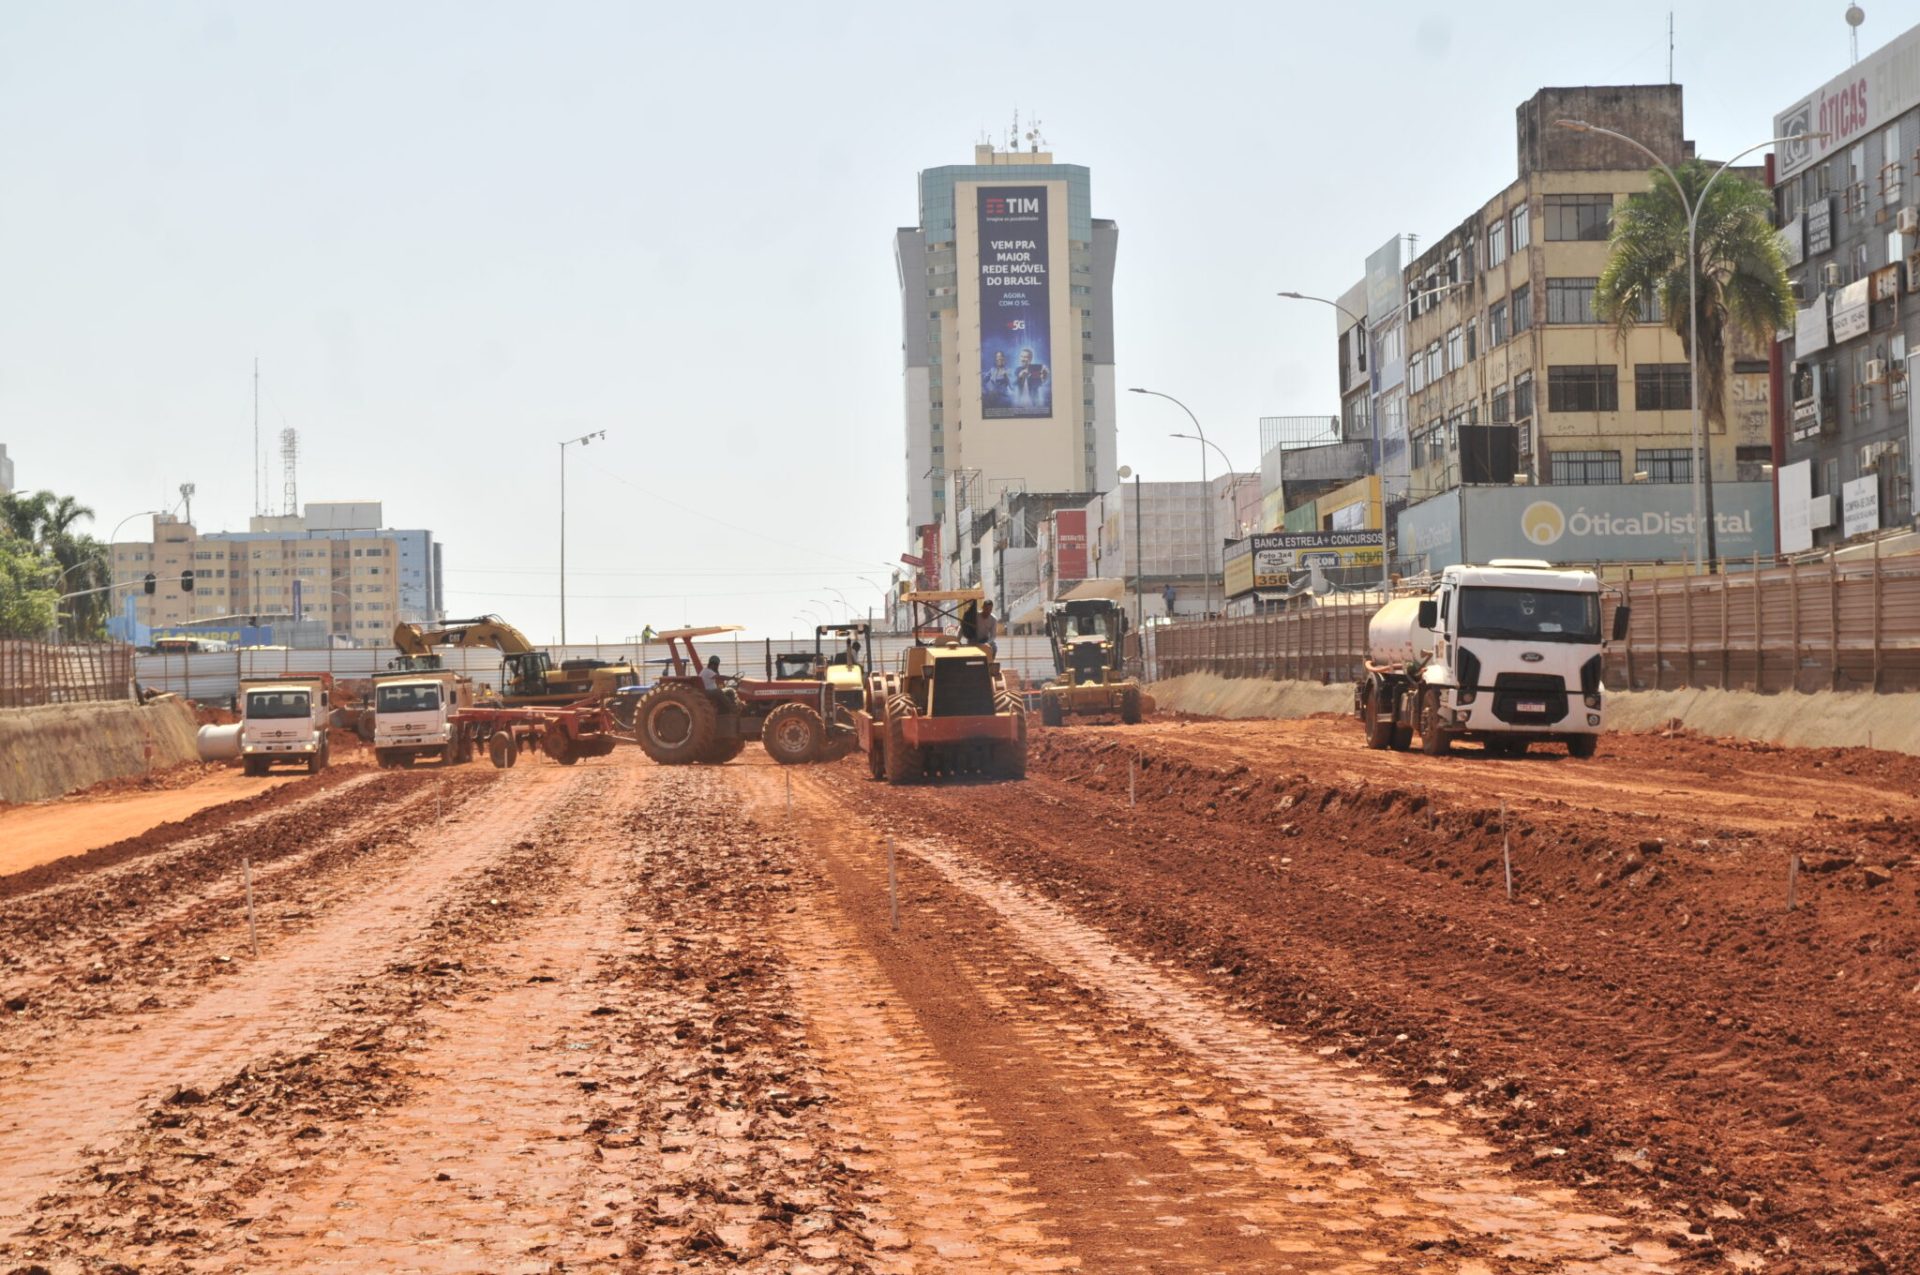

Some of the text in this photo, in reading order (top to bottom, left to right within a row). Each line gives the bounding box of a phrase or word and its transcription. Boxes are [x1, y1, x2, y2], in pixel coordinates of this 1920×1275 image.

[1818, 77, 1868, 151] ÓTICAS
[1006, 198, 1040, 214] TIM
[991, 240, 1036, 250] VEM PRA
[996, 252, 1031, 262] MAIOR
[982, 261, 1046, 274] REDE MÓVEL
[986, 276, 1042, 286] DO BRASIL.
[1012, 319, 1026, 331] 5G
[1568, 506, 1753, 537] ÓticaDistrtal
[1254, 537, 1284, 549] BANCA
[1285, 535, 1323, 548] ESTRELA
[1331, 533, 1384, 545] CONCURSOS
[1258, 551, 1292, 560] Foto 3x4
[1258, 575, 1288, 586] 356
